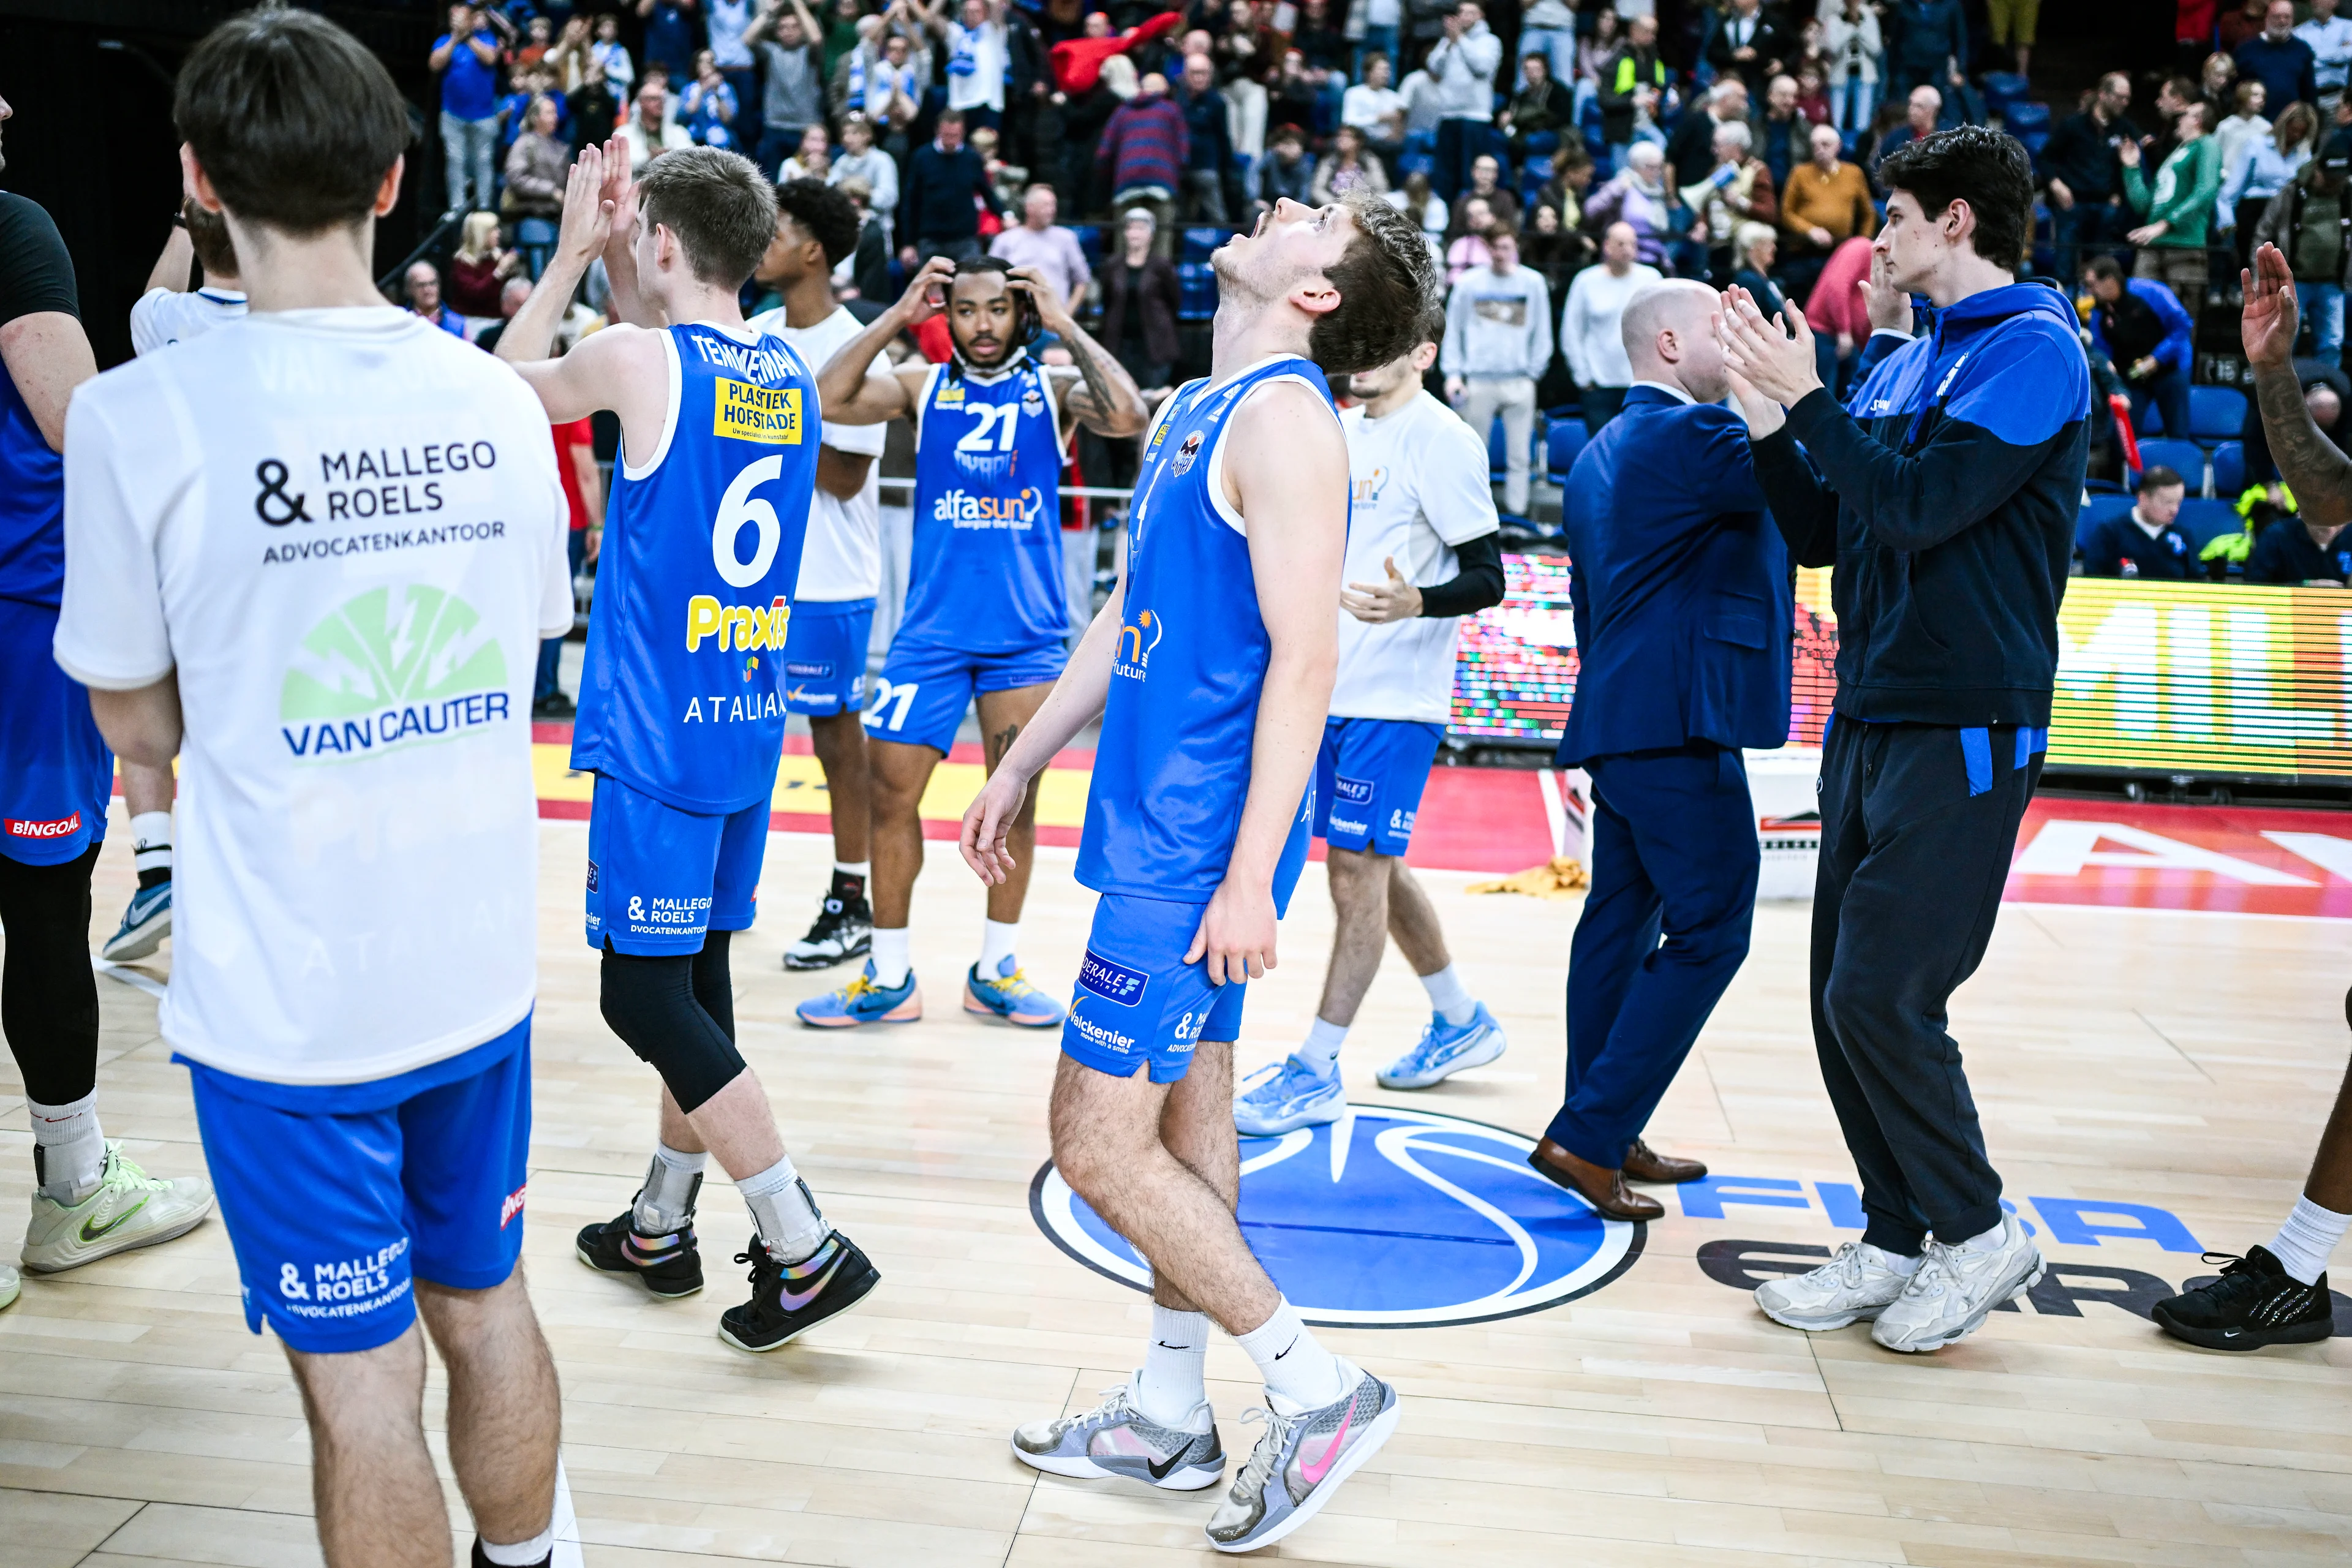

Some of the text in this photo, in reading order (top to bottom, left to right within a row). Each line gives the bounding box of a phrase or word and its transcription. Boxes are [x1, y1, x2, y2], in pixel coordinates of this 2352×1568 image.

[691, 334, 802, 385] TEMMEMAN
[724, 404, 796, 429] HOFSTADE
[729, 383, 792, 410] PLASTIEK
[957, 402, 1019, 451] 21
[320, 441, 496, 483] MALLEGO
[255, 458, 315, 527] &
[328, 482, 443, 522] ROELS
[933, 489, 1025, 521] alfasun
[712, 454, 783, 588] 6
[263, 521, 505, 565] ADVOCATENKANTOOR
[686, 595, 791, 653] Praxis
[282, 692, 510, 756] VAN CAUTER
[859, 677, 919, 732] 21
[628, 895, 646, 922] &
[651, 911, 695, 923] ROELS
[652, 897, 712, 910] MALLEGO
[1082, 956, 1126, 987] DERALE
[1071, 1008, 1135, 1049] Valckenier
[1080, 1032, 1094, 1042] move
[1095, 1038, 1106, 1047] with
[1112, 1045, 1129, 1054] smile
[1175, 1012, 1193, 1039] &
[1676, 1174, 2206, 1254] FIA
[314, 1237, 409, 1282] MALLEGO
[279, 1262, 311, 1300] &
[316, 1269, 390, 1302] ROELS
